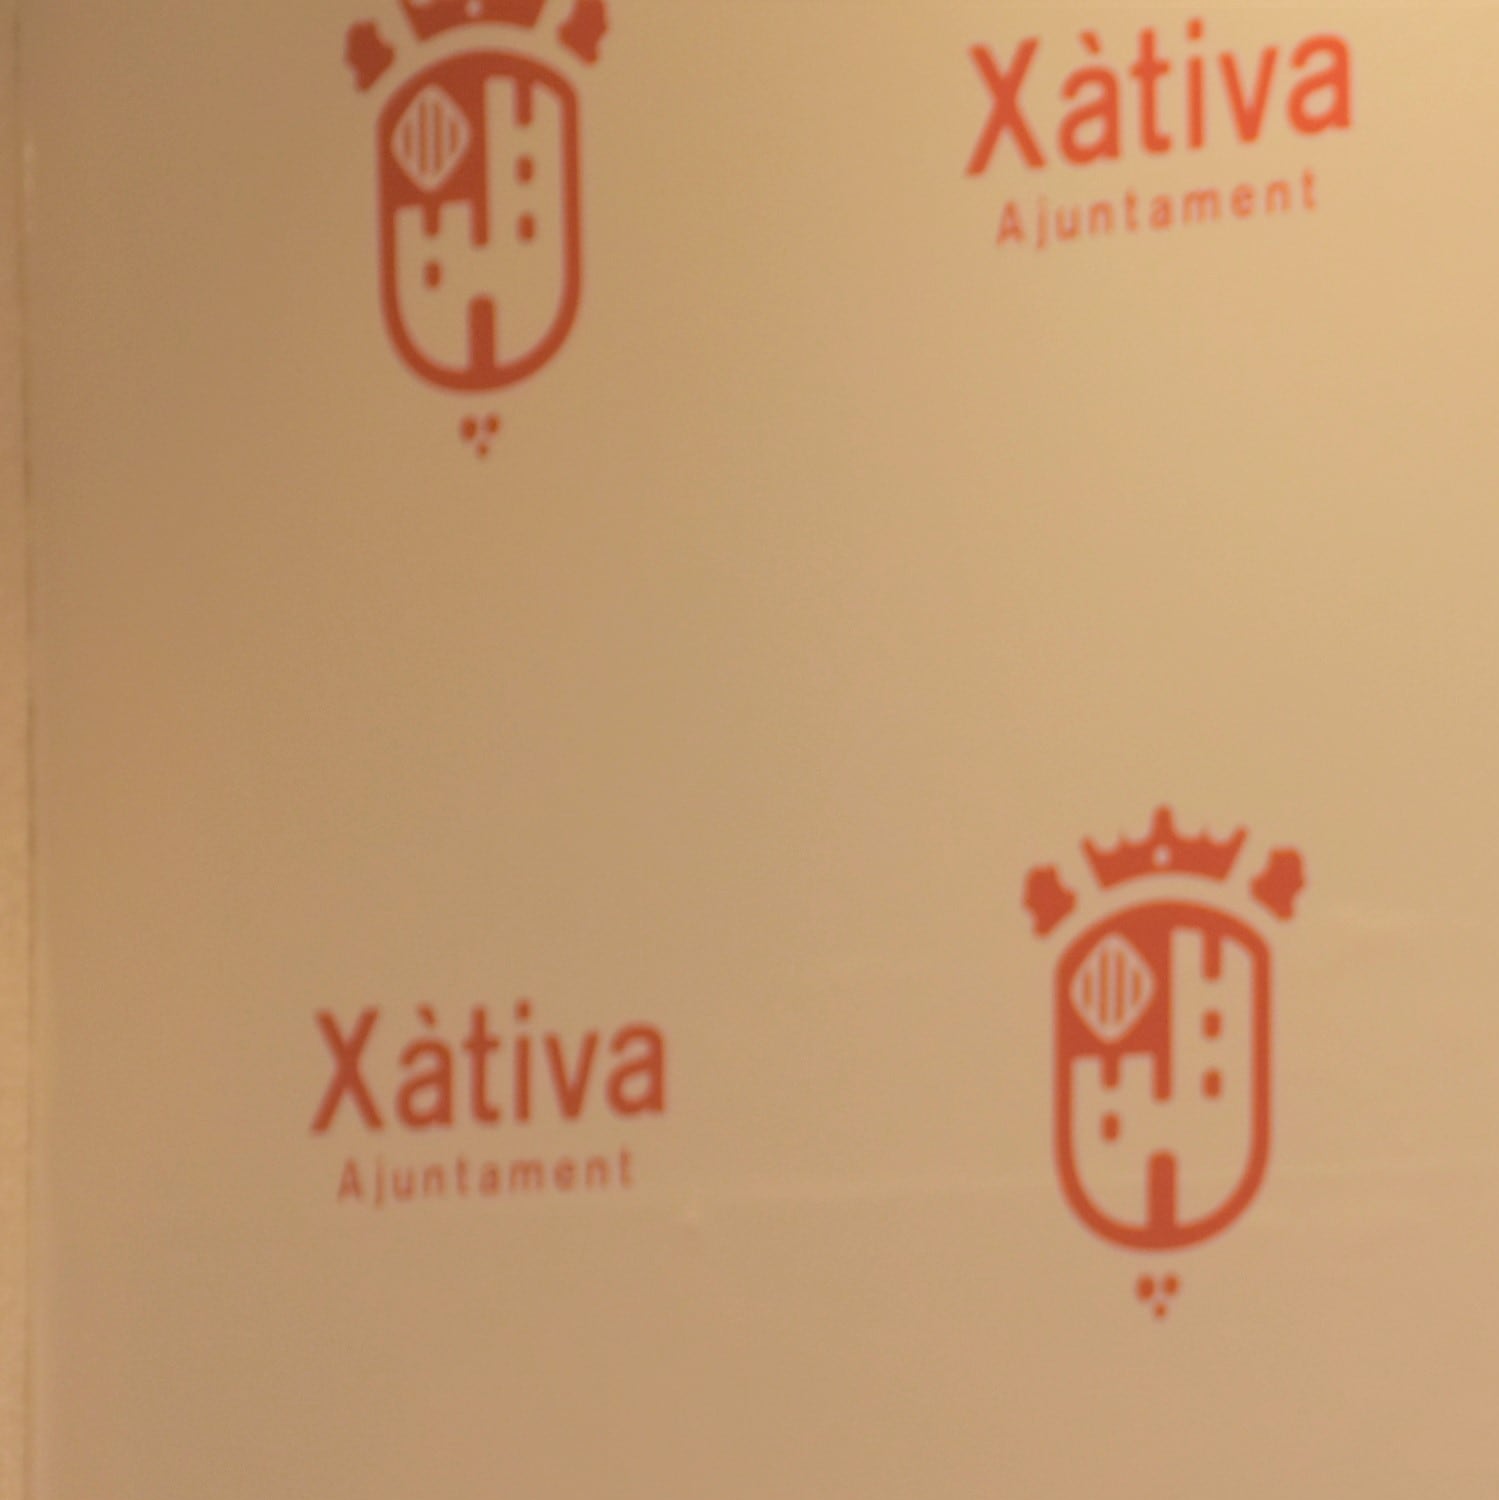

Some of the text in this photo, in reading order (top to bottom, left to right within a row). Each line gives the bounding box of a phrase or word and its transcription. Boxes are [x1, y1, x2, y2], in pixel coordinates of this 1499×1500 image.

[965, 15, 1356, 179] Xàtiva
[997, 169, 1316, 248] Ajuntament
[312, 1000, 667, 1135] Xàtiva
[341, 1151, 630, 1203] Ajuntament
